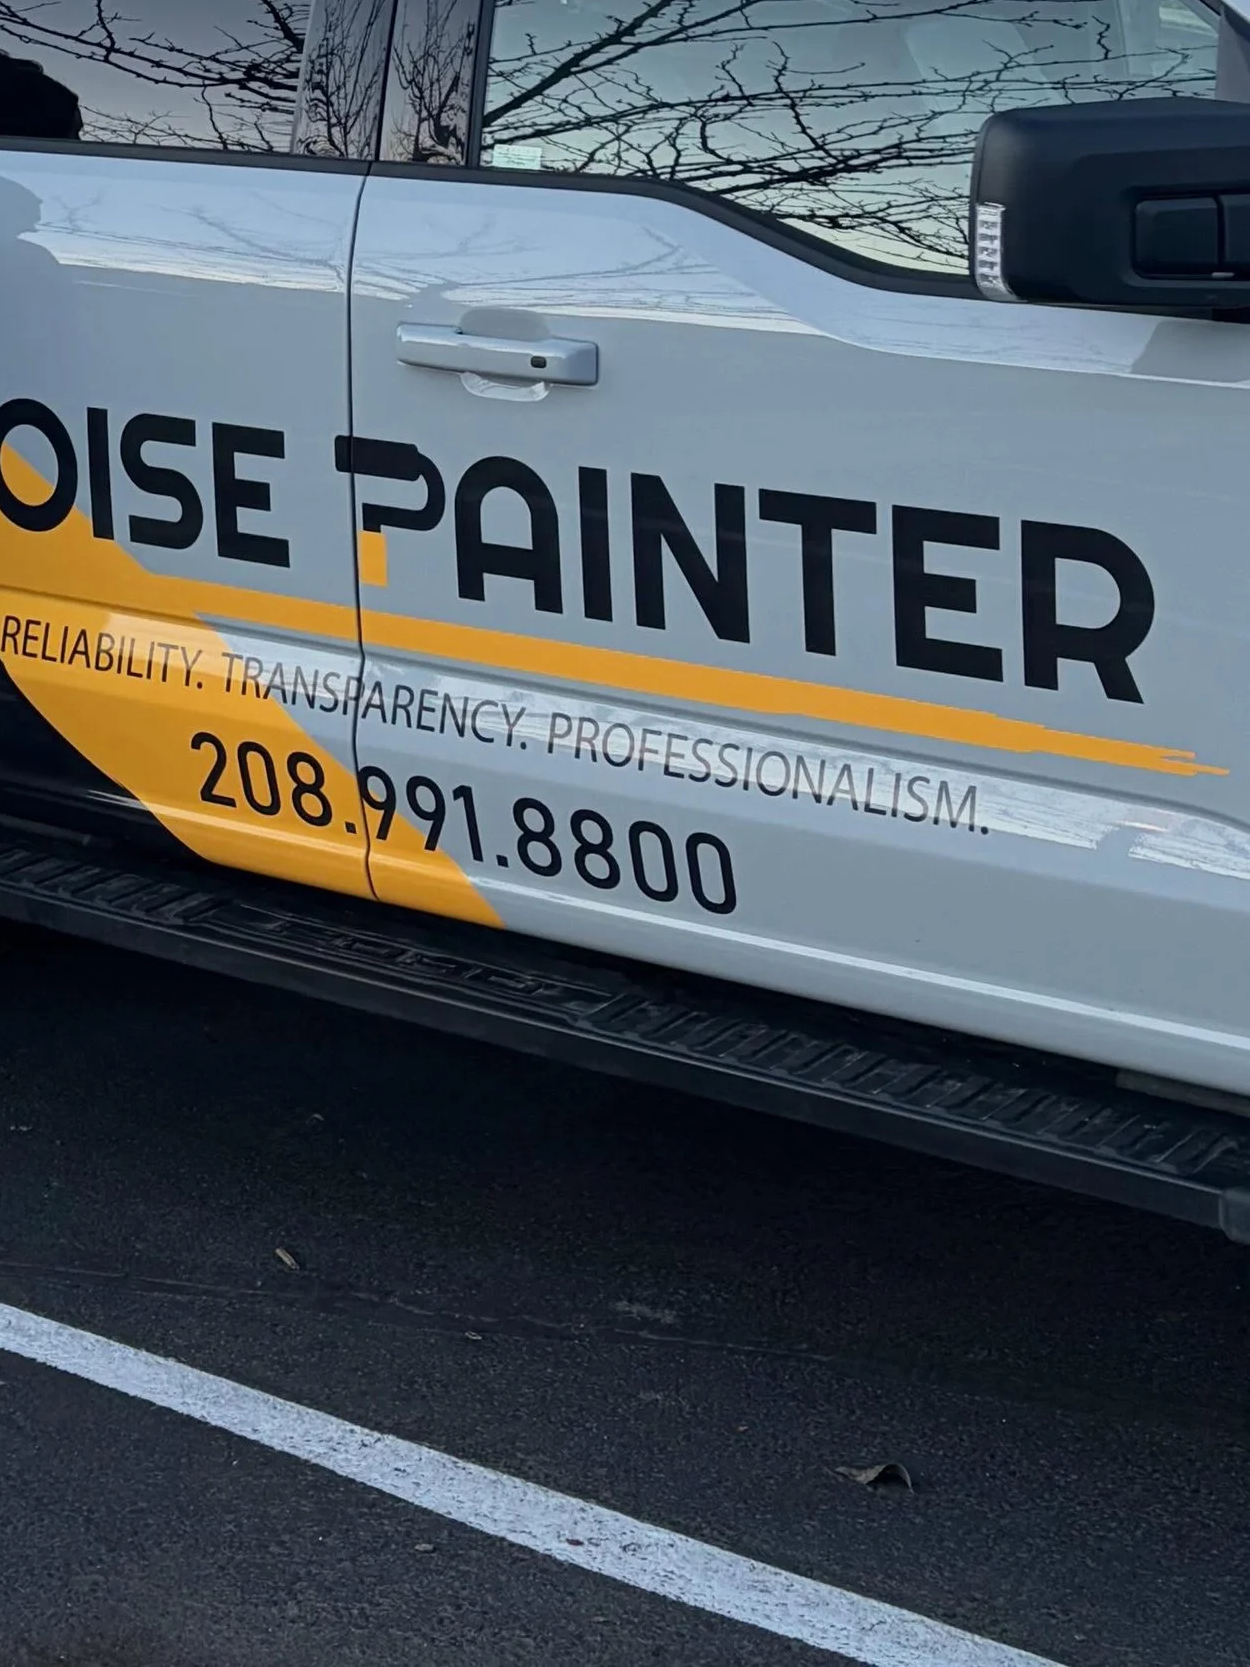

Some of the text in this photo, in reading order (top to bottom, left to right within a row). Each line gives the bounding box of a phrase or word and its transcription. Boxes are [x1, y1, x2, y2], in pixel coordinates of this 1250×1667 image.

[334, 434, 1155, 705] PAINTER
[0, 614, 990, 835] RELIABILITY. TRANSPARENCY. PROFESSIONALISM.
[189, 731, 738, 915] 208.991.8800
